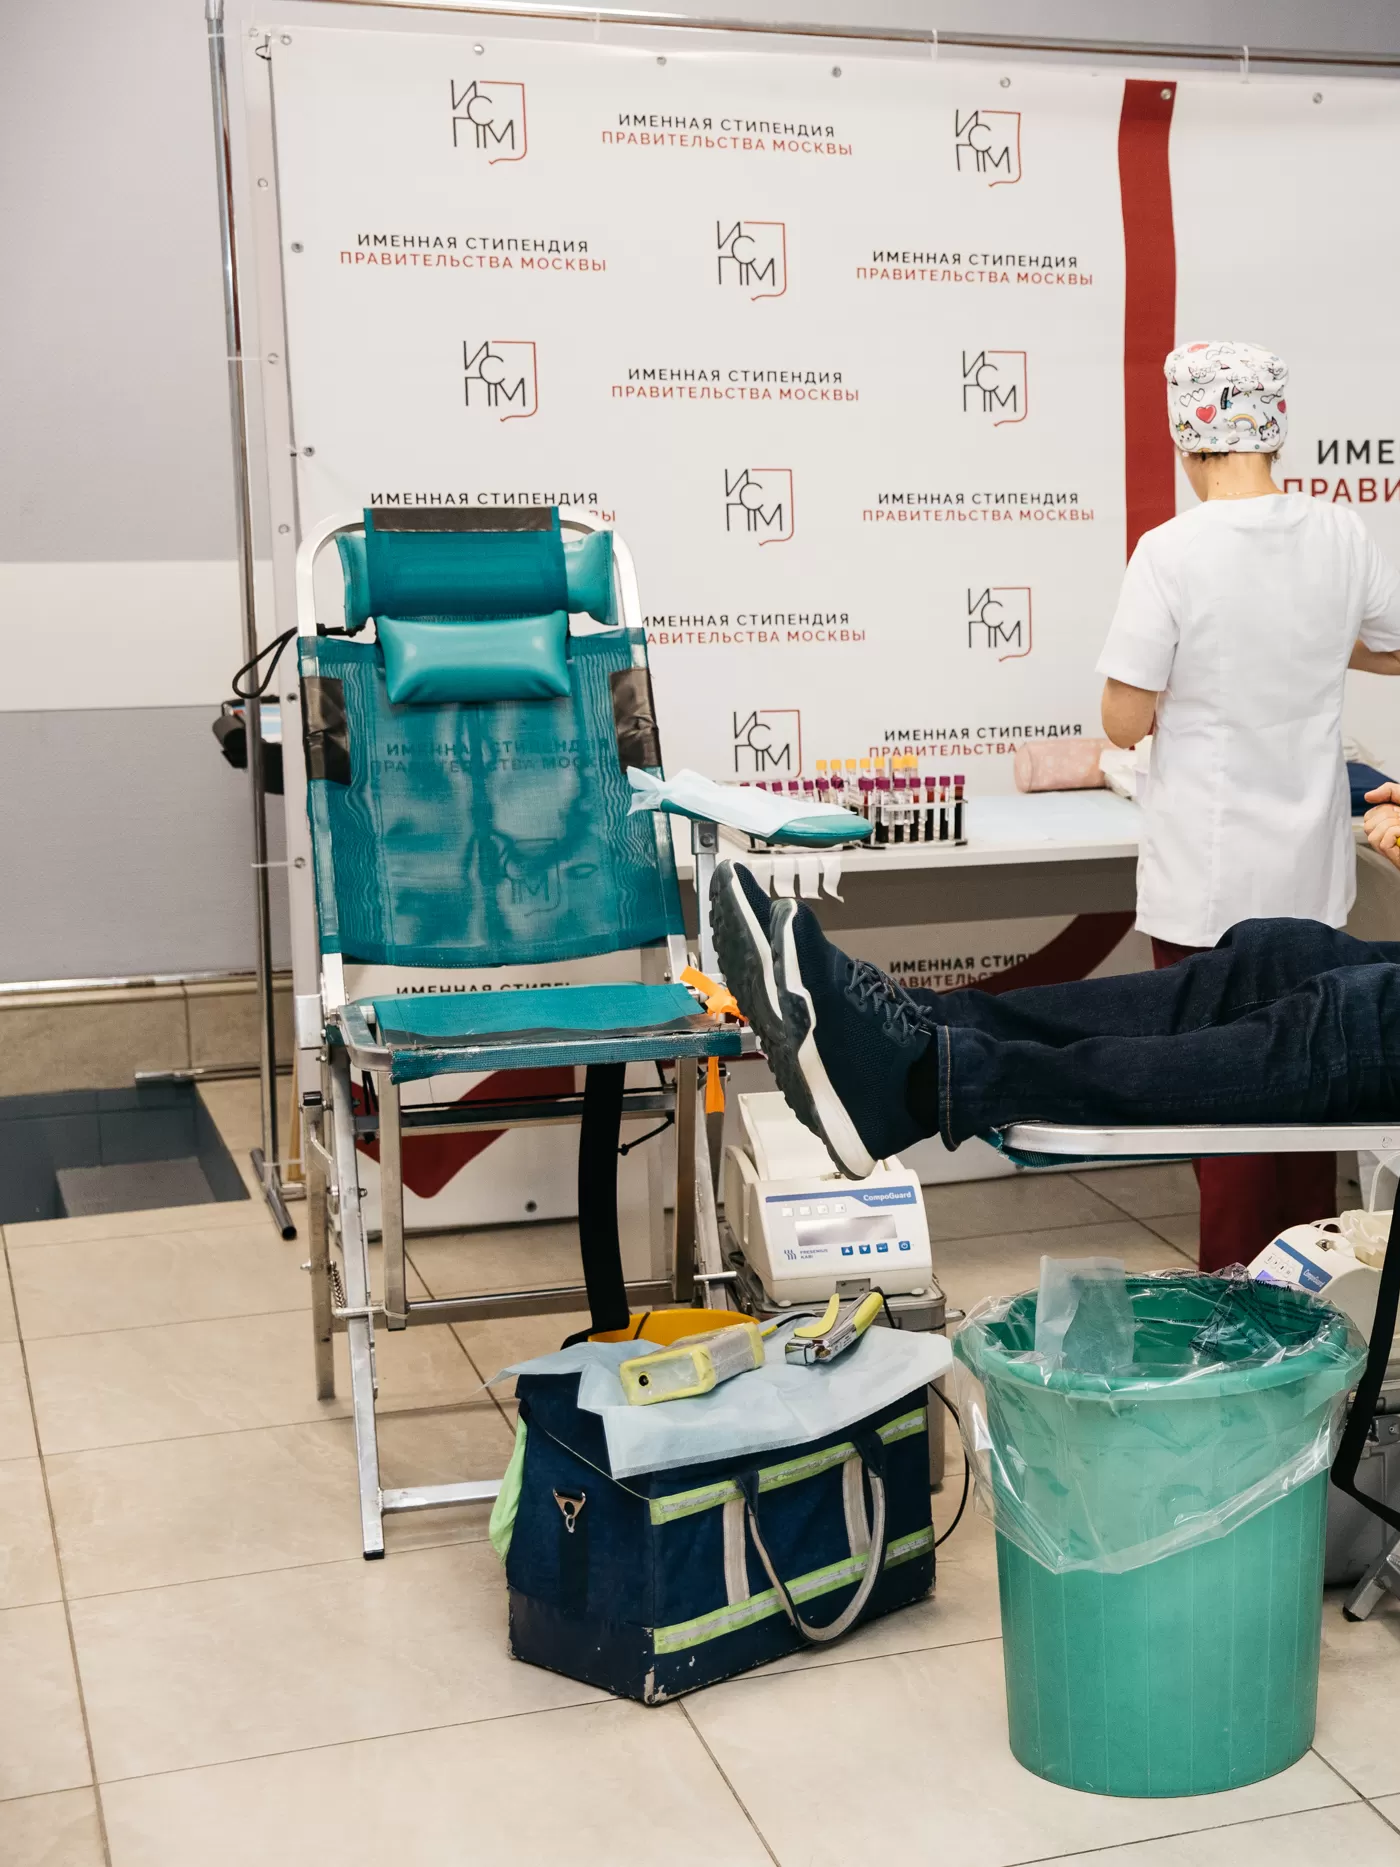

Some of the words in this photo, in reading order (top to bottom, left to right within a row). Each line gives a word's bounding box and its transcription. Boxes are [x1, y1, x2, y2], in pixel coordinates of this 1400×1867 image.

[619, 115, 711, 129] ИМЕННАЯ
[721, 120, 834, 137] СТИПЕНДИЯ
[602, 131, 766, 150] ПРАВИТЕЛЬСТВА
[773, 139, 852, 155] МОСКВЫ
[358, 234, 456, 248] ИМЕННАЯ
[466, 238, 587, 253] СТИПЕНДИЯ
[340, 251, 512, 268] ПРАВИТЕЛЬСТВА
[520, 256, 606, 271] МОСКВЫ
[874, 251, 960, 264] ИМЕННАЯ
[969, 254, 1076, 268] СТИПЕНДИЯ
[857, 267, 1008, 283] ПРАВИТЕЛЬСТВА
[1016, 272, 1092, 285] МОСКВЫ
[629, 369, 719, 381] ИМЕННАЯ
[729, 371, 841, 384] СТИПЕНДИЯ
[612, 385, 771, 400] ПРАВИТЕЛЬСТВА
[779, 388, 858, 400] МОСКВЫ
[371, 493, 469, 505] ИМЕННАЯ
[477, 493, 598, 507] СТИПЕНДИЯ
[879, 494, 964, 504] ИМЕННАЯ
[972, 493, 1077, 505] СТИПЕНДИЯ
[863, 510, 1013, 520] ПРАВИТЕЛЬСТВА
[1019, 509, 1094, 520] МОСКВЫ
[737, 614, 848, 626] СТИПЕНДИЯ
[646, 631, 780, 645] АВИТЕЛЬСТВА
[786, 630, 866, 643] МОСКВЫ
[885, 728, 969, 741] ИМЕННАЯ
[977, 724, 1081, 738] СТИПЕНДИЯ
[868, 742, 1018, 759] ПРАВИТЕЛЬСТВА
[889, 956, 975, 974] ИМЕННАЯ
[863, 1191, 912, 1202] CompoGuard
